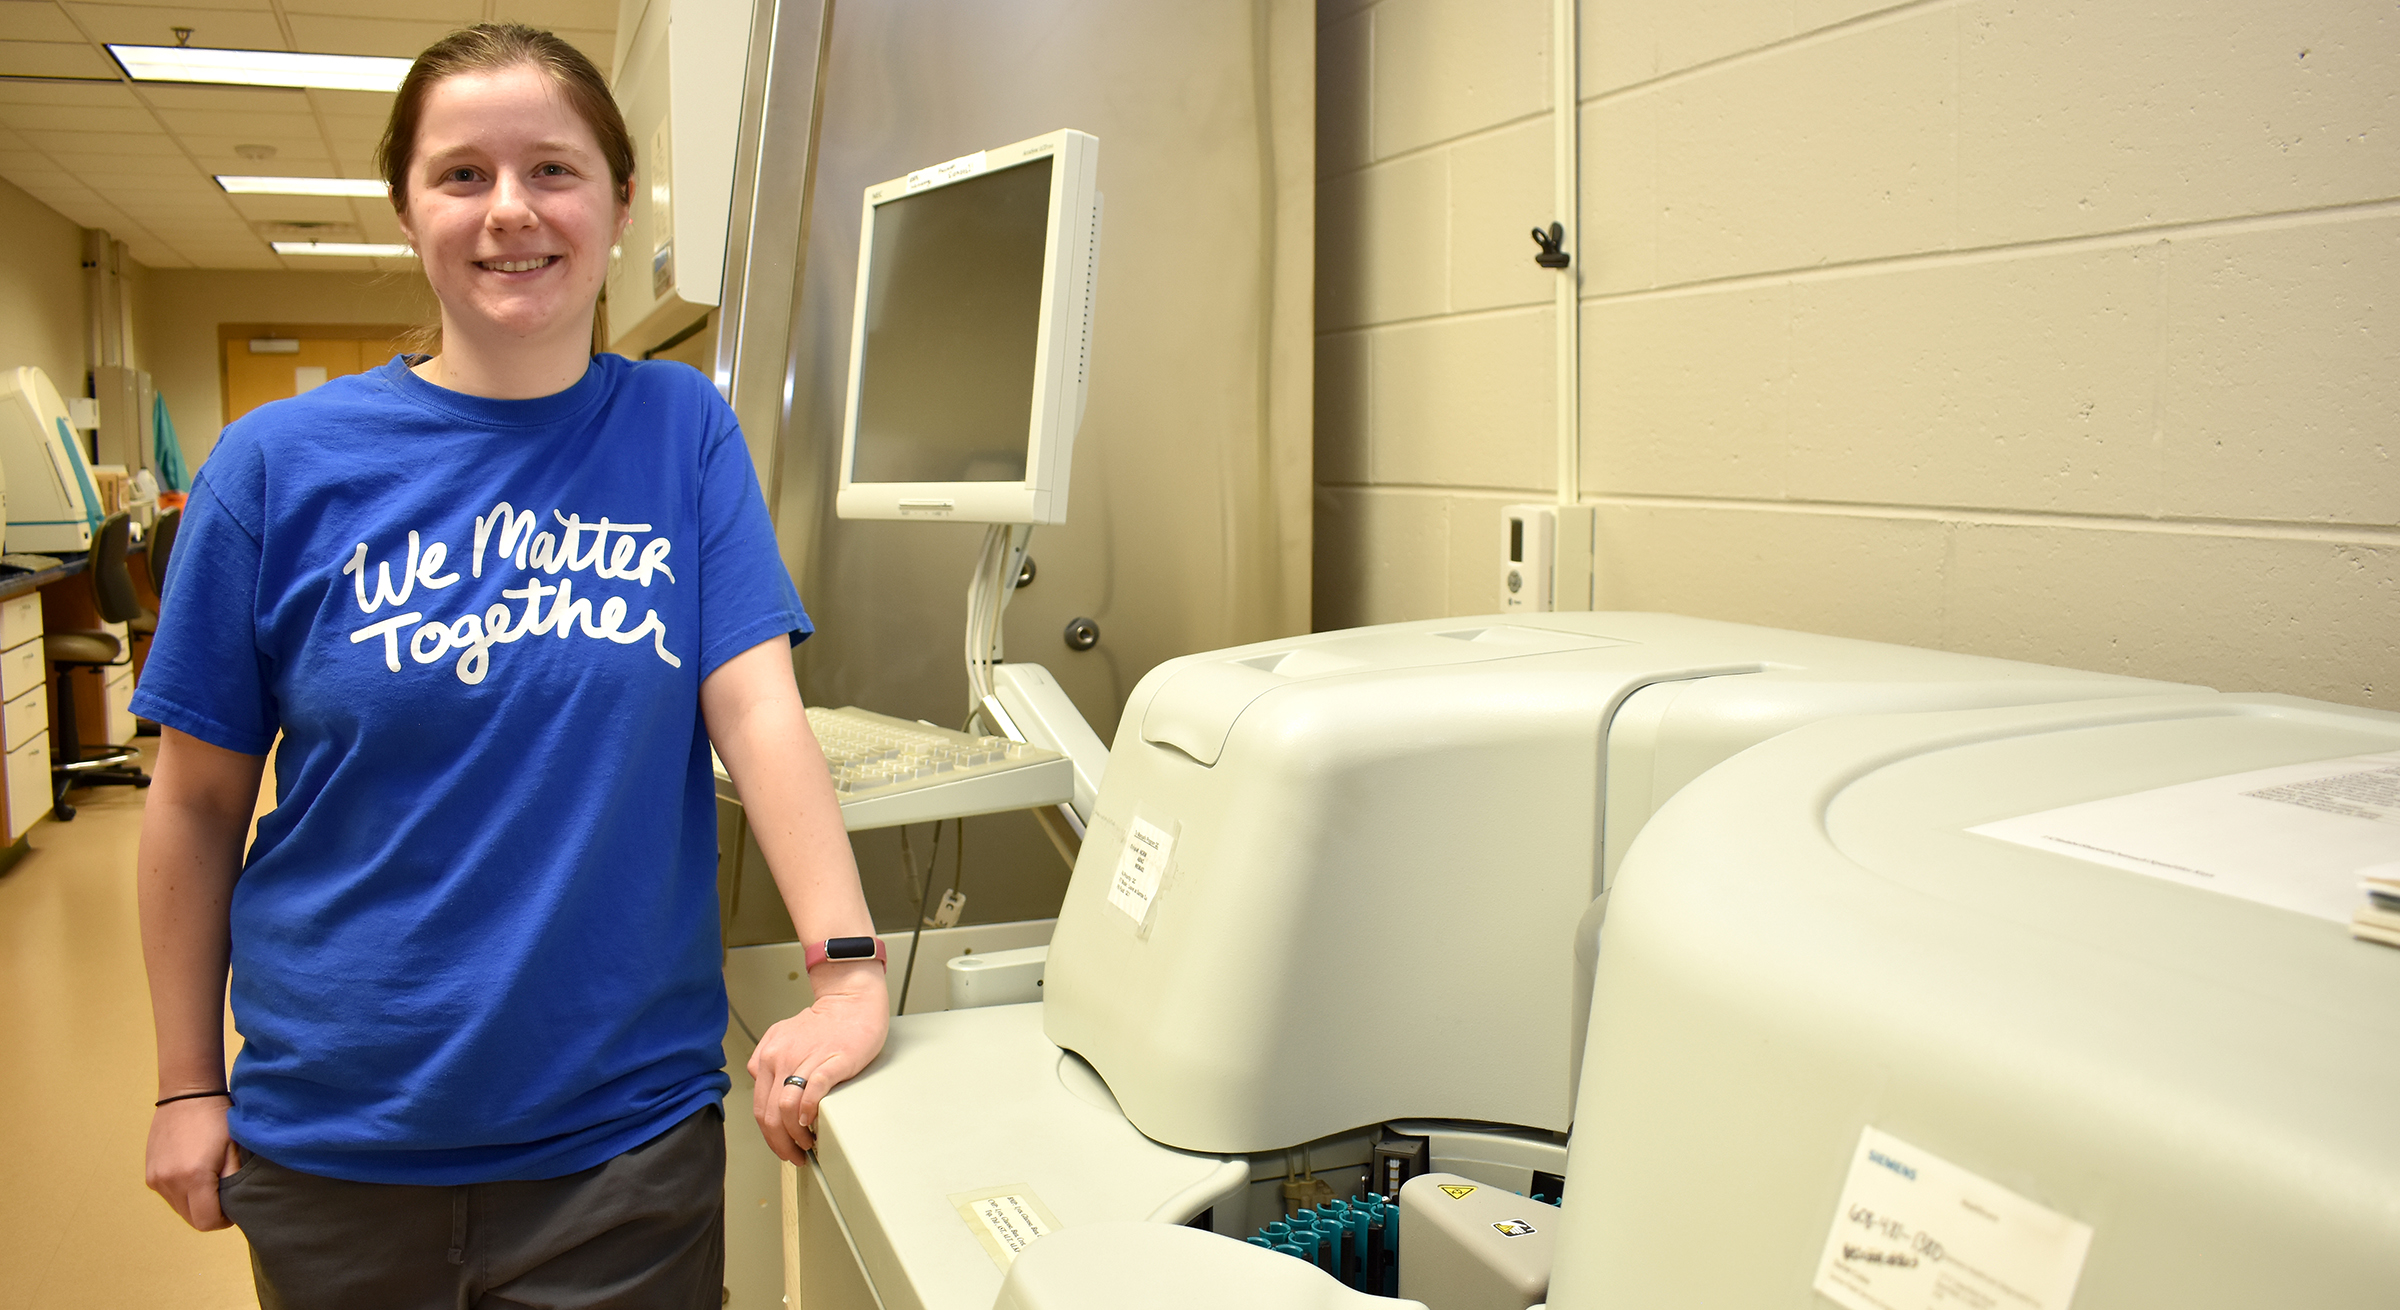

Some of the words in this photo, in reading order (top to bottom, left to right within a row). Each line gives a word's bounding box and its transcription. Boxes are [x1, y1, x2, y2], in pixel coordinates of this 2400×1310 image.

[343, 530, 460, 613] We
[350, 578, 681, 685] Together
[1868, 1149, 1917, 1181] SIEMENS
